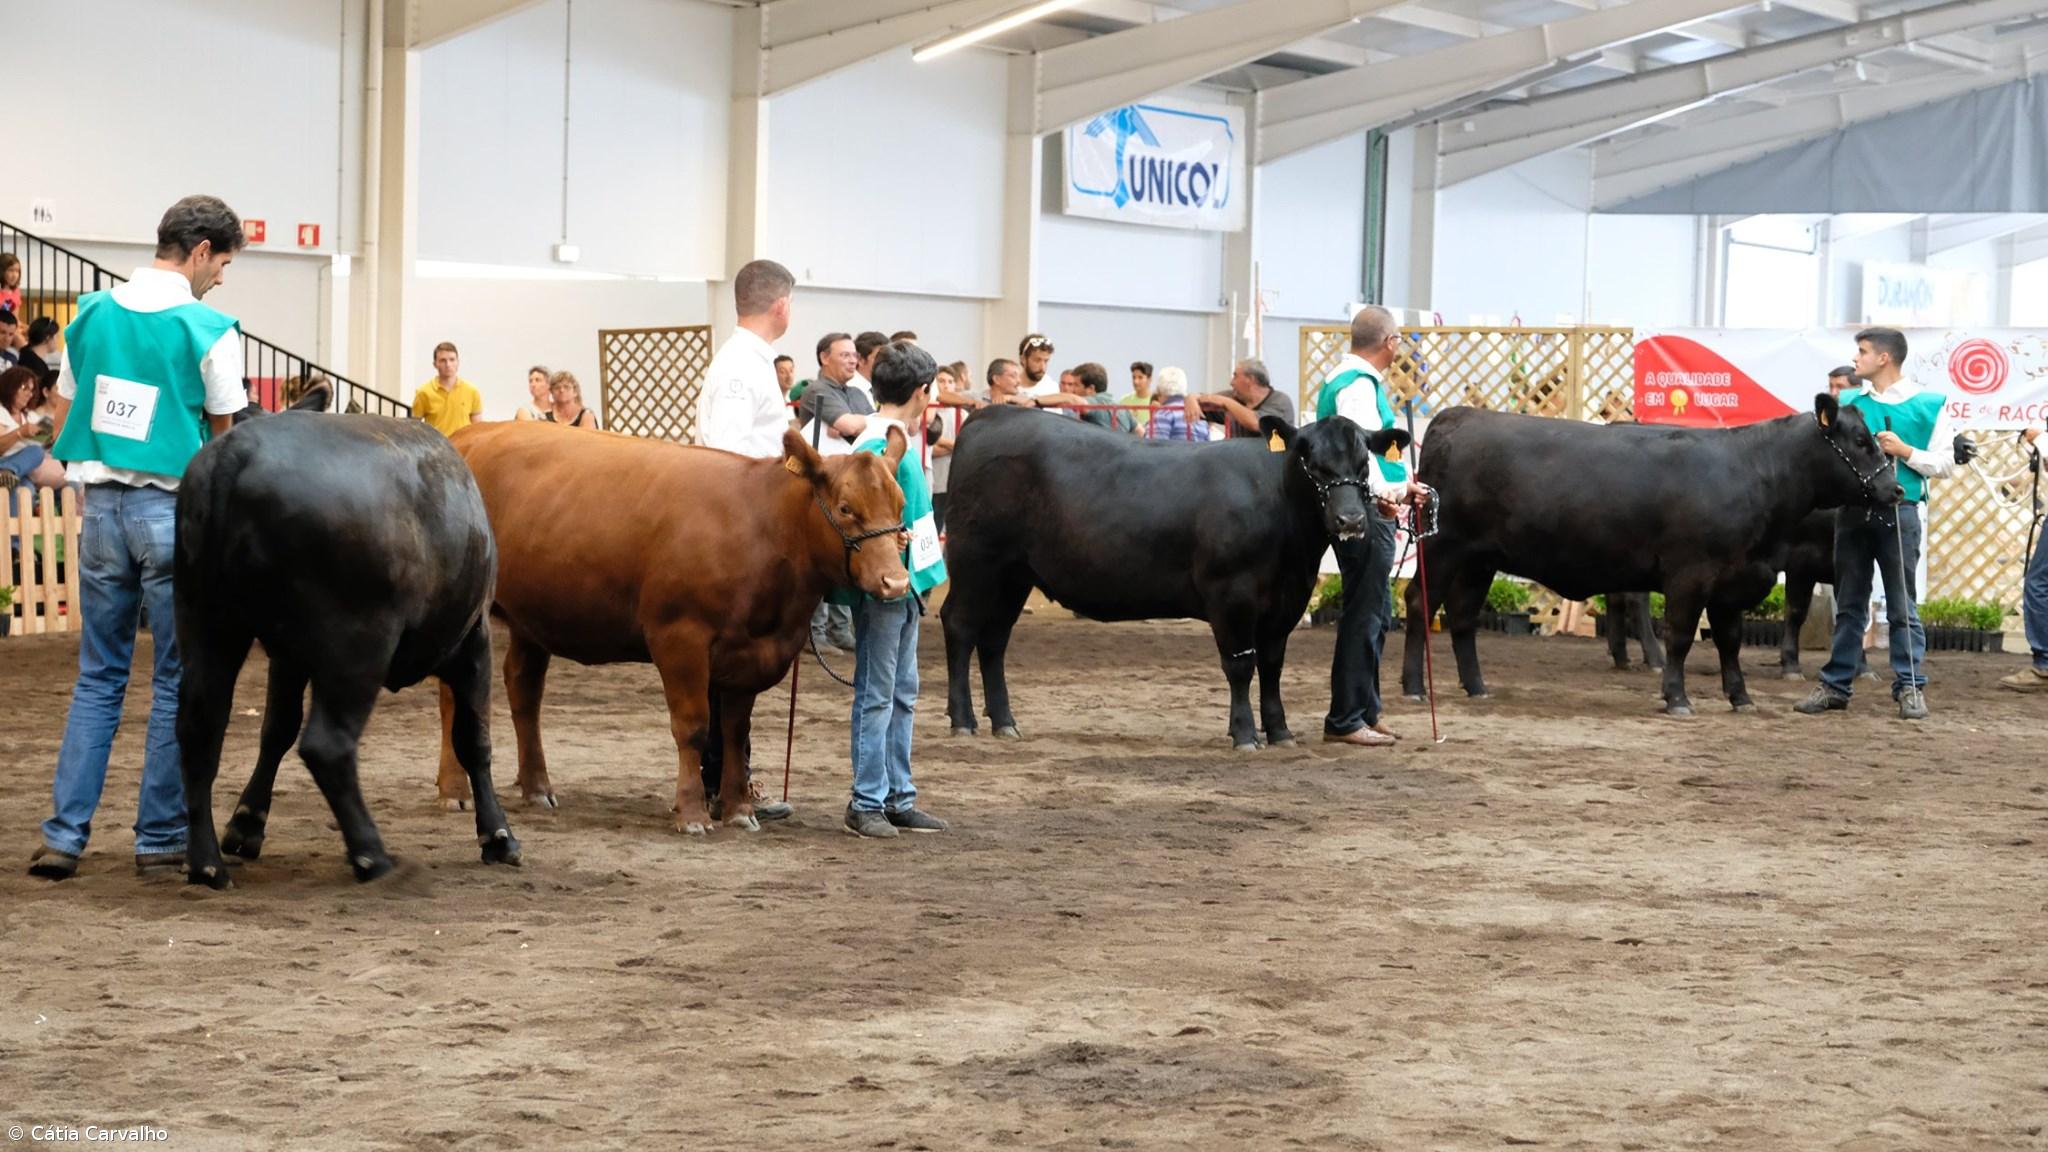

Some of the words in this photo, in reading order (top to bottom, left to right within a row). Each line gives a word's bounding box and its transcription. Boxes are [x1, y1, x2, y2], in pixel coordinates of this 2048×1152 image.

[1645, 372, 1656, 385] A
[1657, 372, 1731, 388] QUALIDADE
[1645, 392, 1665, 406] EM
[1694, 392, 1738, 407] LUGAR
[106, 399, 137, 418] 037
